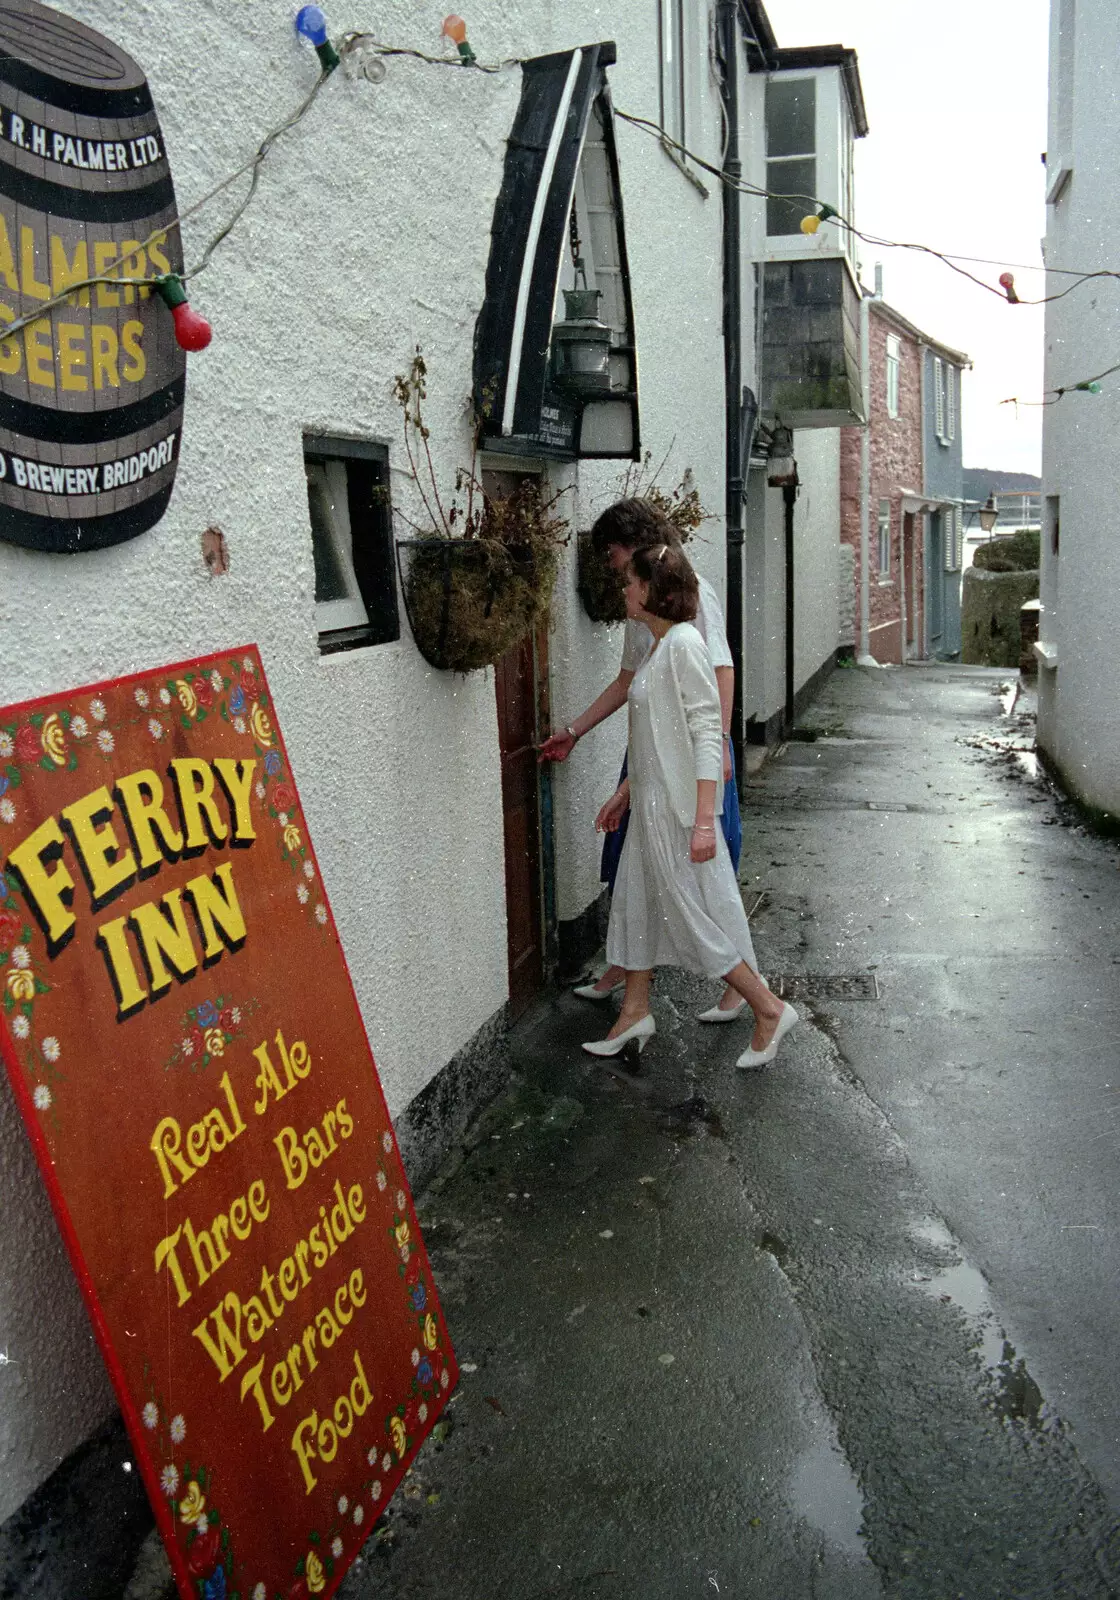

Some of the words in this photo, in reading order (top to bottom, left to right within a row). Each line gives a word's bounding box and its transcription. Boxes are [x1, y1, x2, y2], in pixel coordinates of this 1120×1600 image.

[130, 135, 162, 167] LTD.
[12, 457, 100, 494] BREWERY,
[103, 434, 176, 490] BRIDPORT
[5, 758, 257, 961] FERRY
[96, 861, 247, 1024] INN
[150, 1070, 247, 1200] Real
[252, 1028, 312, 1116] Ale
[154, 1178, 271, 1308] Three
[272, 1097, 354, 1190] Bars
[191, 1178, 367, 1383] Waterside
[240, 1267, 367, 1433] Terrace
[291, 1349, 374, 1496] Food
